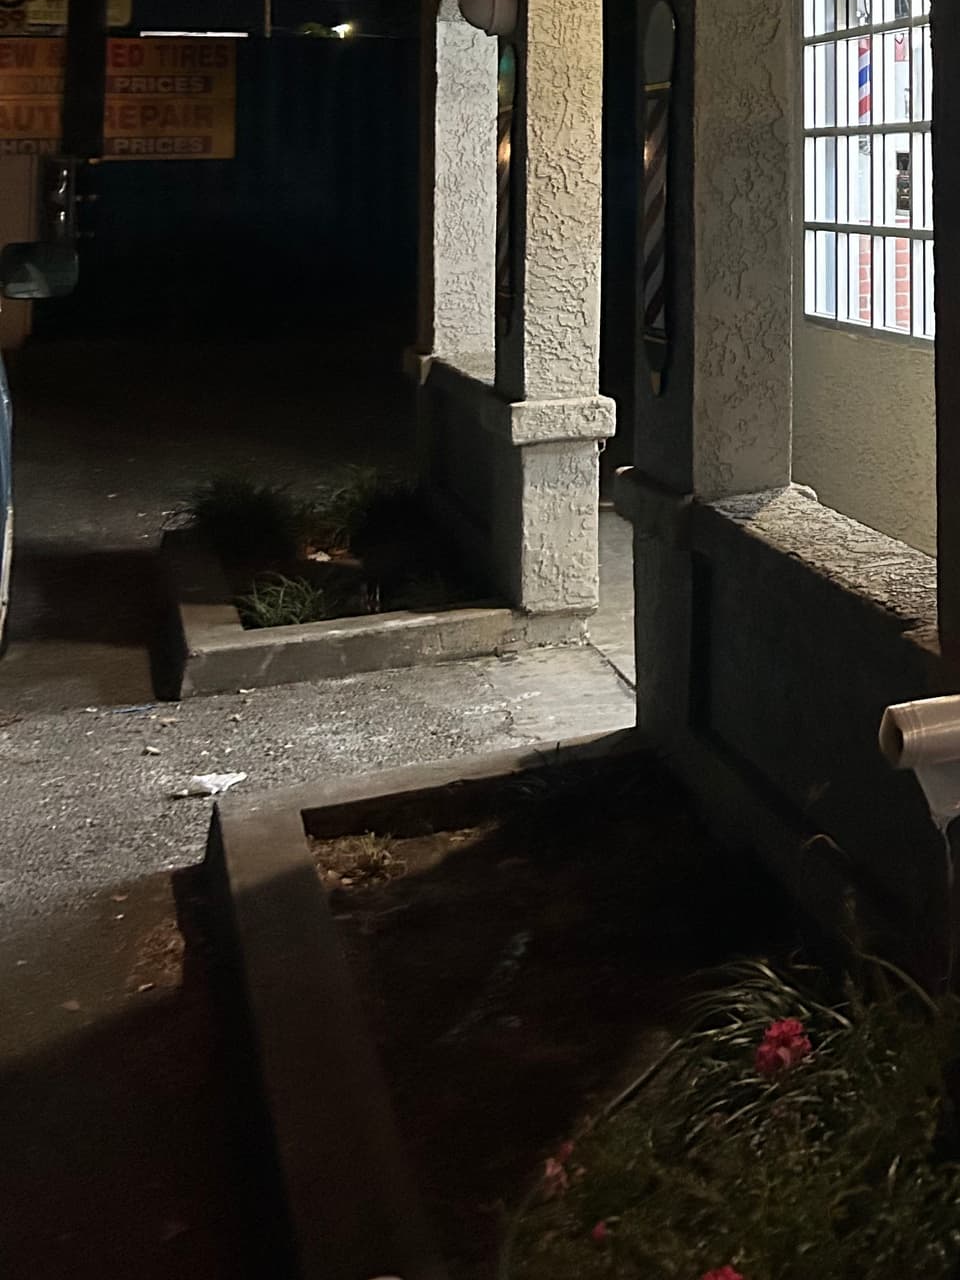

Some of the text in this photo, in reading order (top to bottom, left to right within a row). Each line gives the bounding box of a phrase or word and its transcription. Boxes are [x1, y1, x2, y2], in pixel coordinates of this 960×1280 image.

[0, 43, 37, 68] EW
[156, 44, 229, 68] TIRES
[112, 76, 206, 93] PRICES
[113, 138, 206, 154] PRICES
